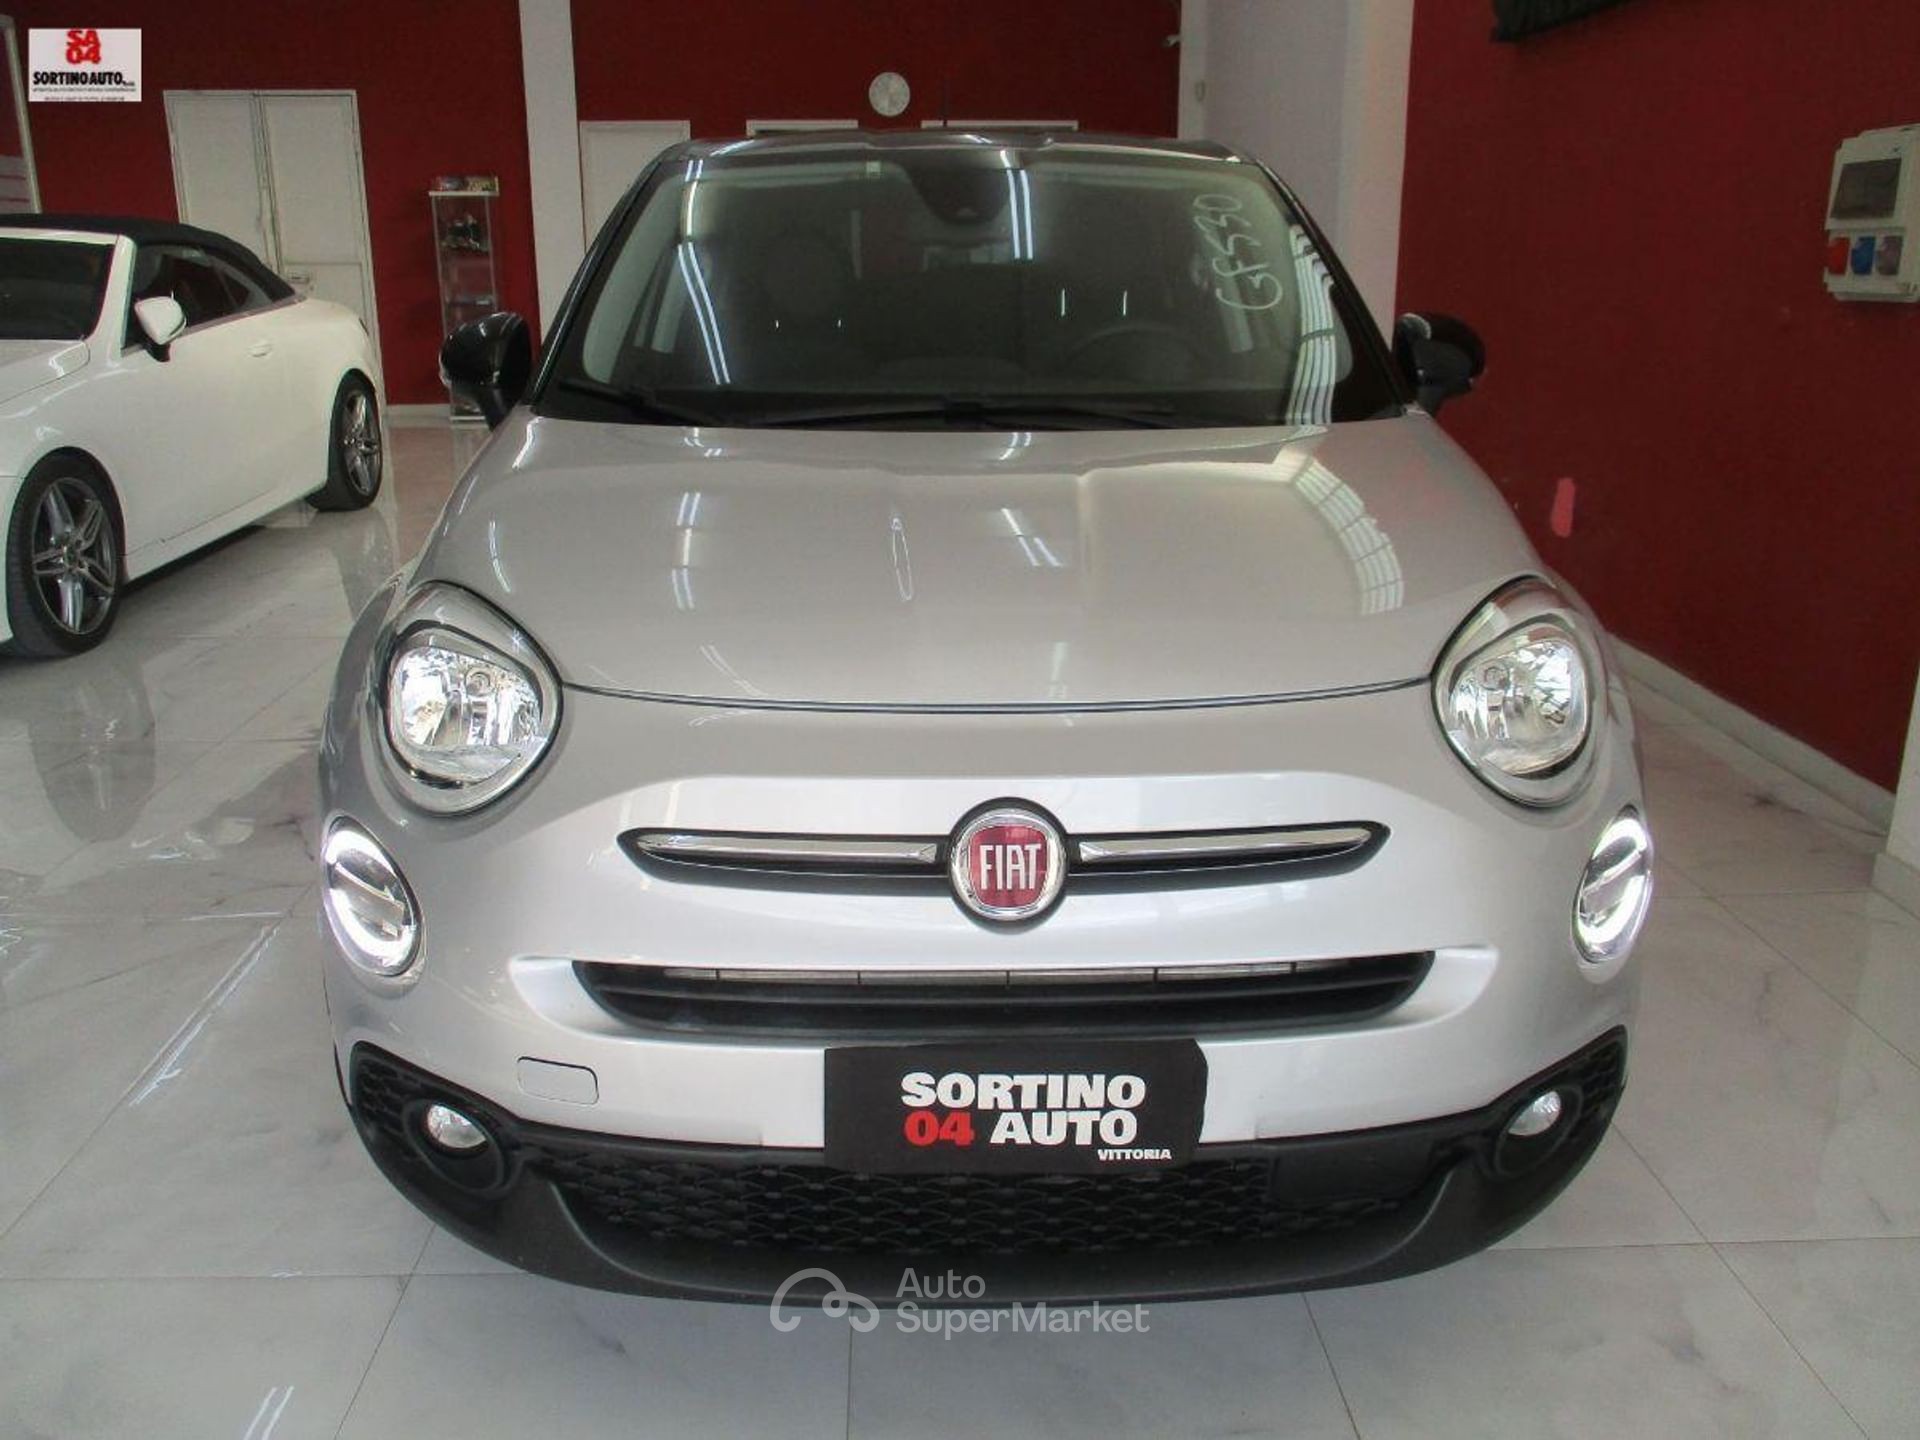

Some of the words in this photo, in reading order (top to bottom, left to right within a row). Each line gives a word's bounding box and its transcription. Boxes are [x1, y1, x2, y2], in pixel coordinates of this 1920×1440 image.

[980, 843, 1042, 890] FIAT
[901, 1072, 1146, 1110] SORTINO
[904, 1110, 975, 1146] 04
[990, 1110, 1137, 1146] AUTO
[1098, 1149, 1172, 1161] VITTORIA
